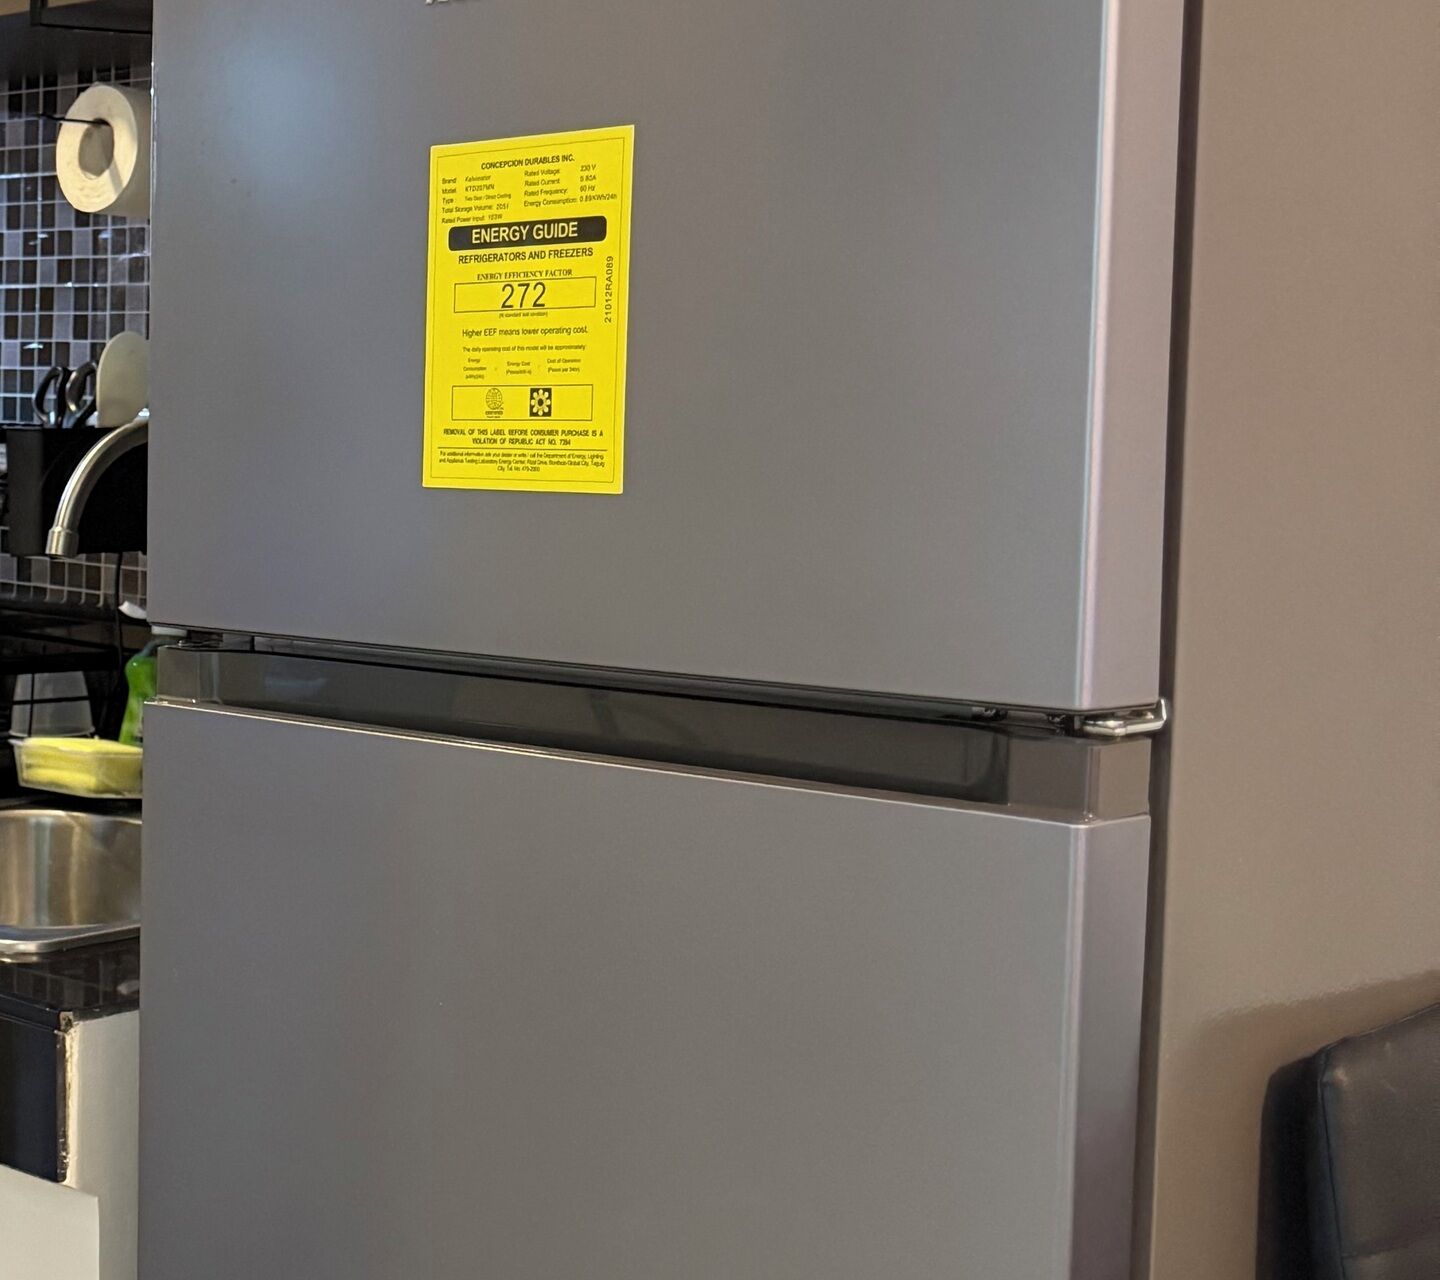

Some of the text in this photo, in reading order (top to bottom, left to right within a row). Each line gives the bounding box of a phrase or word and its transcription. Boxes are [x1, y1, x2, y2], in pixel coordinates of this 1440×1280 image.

[481, 154, 575, 170] CONCEPCION DURABLES INC.
[472, 222, 578, 244] ENERGY GUIDE
[458, 248, 594, 264] REFRIGERATORS AND FREEZERS
[477, 269, 572, 280] ENERGY EFFICIENCY FACTOR
[500, 282, 546, 309] 272
[604, 256, 614, 324] 21012RA089
[462, 328, 482, 338] Higher
[484, 328, 496, 336] EEF
[498, 328, 520, 336] means
[521, 327, 539, 336] lower
[540, 326, 572, 336] operating
[508, 438, 534, 446] REPUBLIC
[535, 438, 545, 446] ACT
